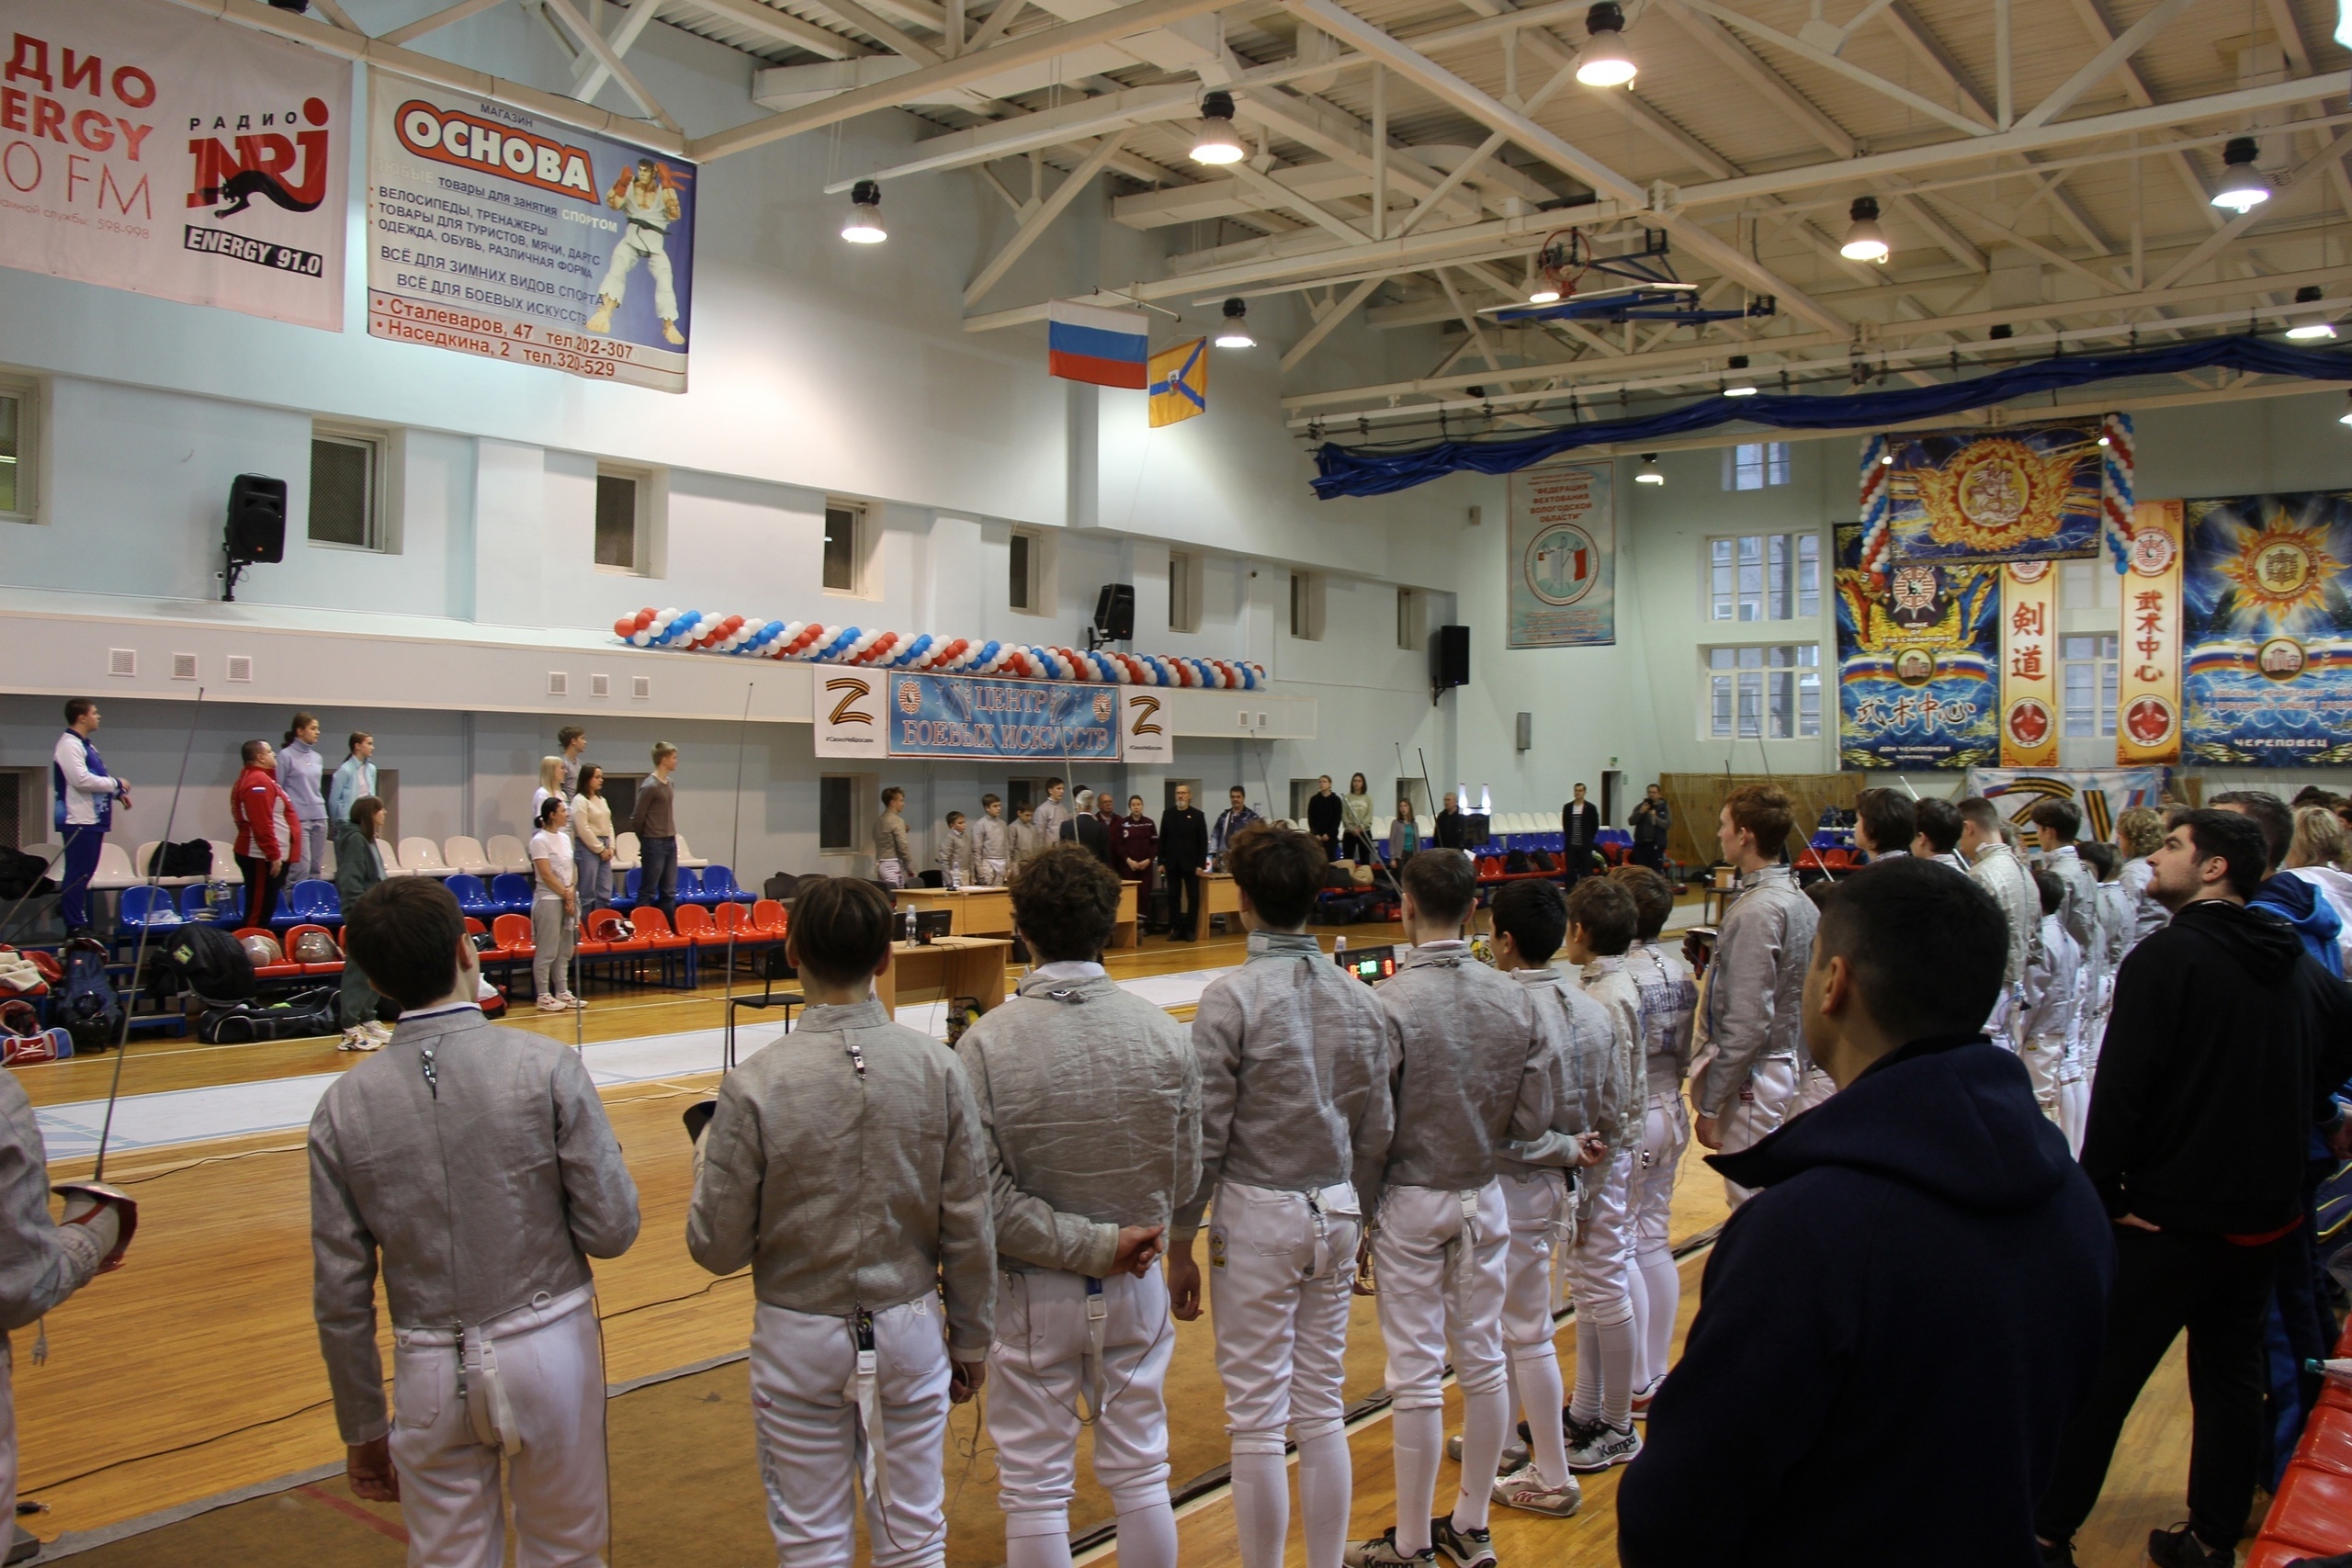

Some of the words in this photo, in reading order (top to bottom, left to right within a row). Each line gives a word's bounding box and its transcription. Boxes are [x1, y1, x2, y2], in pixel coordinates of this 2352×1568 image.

[5, 32, 156, 108] ДИО
[1, 85, 153, 162] ERGY
[190, 111, 297, 130] РАДИО
[481, 104, 533, 128] МАГАЗИН
[404, 110, 591, 193] ОСНОВА
[68, 154, 151, 220] FM
[438, 177, 485, 196] товары
[488, 189, 510, 202] для
[514, 197, 558, 217] занятия
[96, 219, 150, 239] 598-998
[379, 186, 473, 218] ВЕЛОСИПЕДЫ,
[477, 209, 548, 236] ТРЕНАЖЕРЫ
[187, 228, 272, 264] ENERGY
[277, 248, 322, 275] 91.0
[379, 202, 434, 223] ТОВАРЫ
[436, 216, 462, 230] ДЛЯ
[466, 222, 528, 247] ТУРИСТОВ,
[532, 239, 565, 257] МЯЧИ,
[568, 248, 600, 265] ДАРТС
[379, 219, 436, 242] ОДЕЖДА,
[441, 232, 484, 253] ОБУВЬ,
[489, 243, 554, 268] РАЗЛИЧНАЯ
[558, 261, 593, 279] ФОРМА
[381, 245, 411, 262] ВСЁ
[414, 253, 445, 269] ДЛЯ
[450, 260, 506, 283] ЗИМНИХ
[510, 275, 555, 294] ВИДОВ
[559, 286, 605, 306] СПОРТА
[390, 299, 507, 336] Сталеваров,
[514, 323, 533, 339] 47
[398, 274, 427, 289] ВСЁ
[431, 280, 460, 296] ДЛЯ
[466, 288, 524, 310] БОЕВЫХ
[526, 301, 588, 325] ИСКУССТВ
[389, 320, 493, 355] Наседкина,
[500, 342, 509, 356] 2
[825, 677, 875, 726] Z
[974, 685, 1048, 715] ЦЕНТР
[1129, 695, 1163, 736] Z
[901, 719, 995, 750] БОЕВЫХ
[1001, 724, 1109, 750] ИСКУССТВ
[2233, 739, 2328, 748] ЧЕРЕПОВЕЦ
[1597, 1437, 1635, 1457] Kempa
